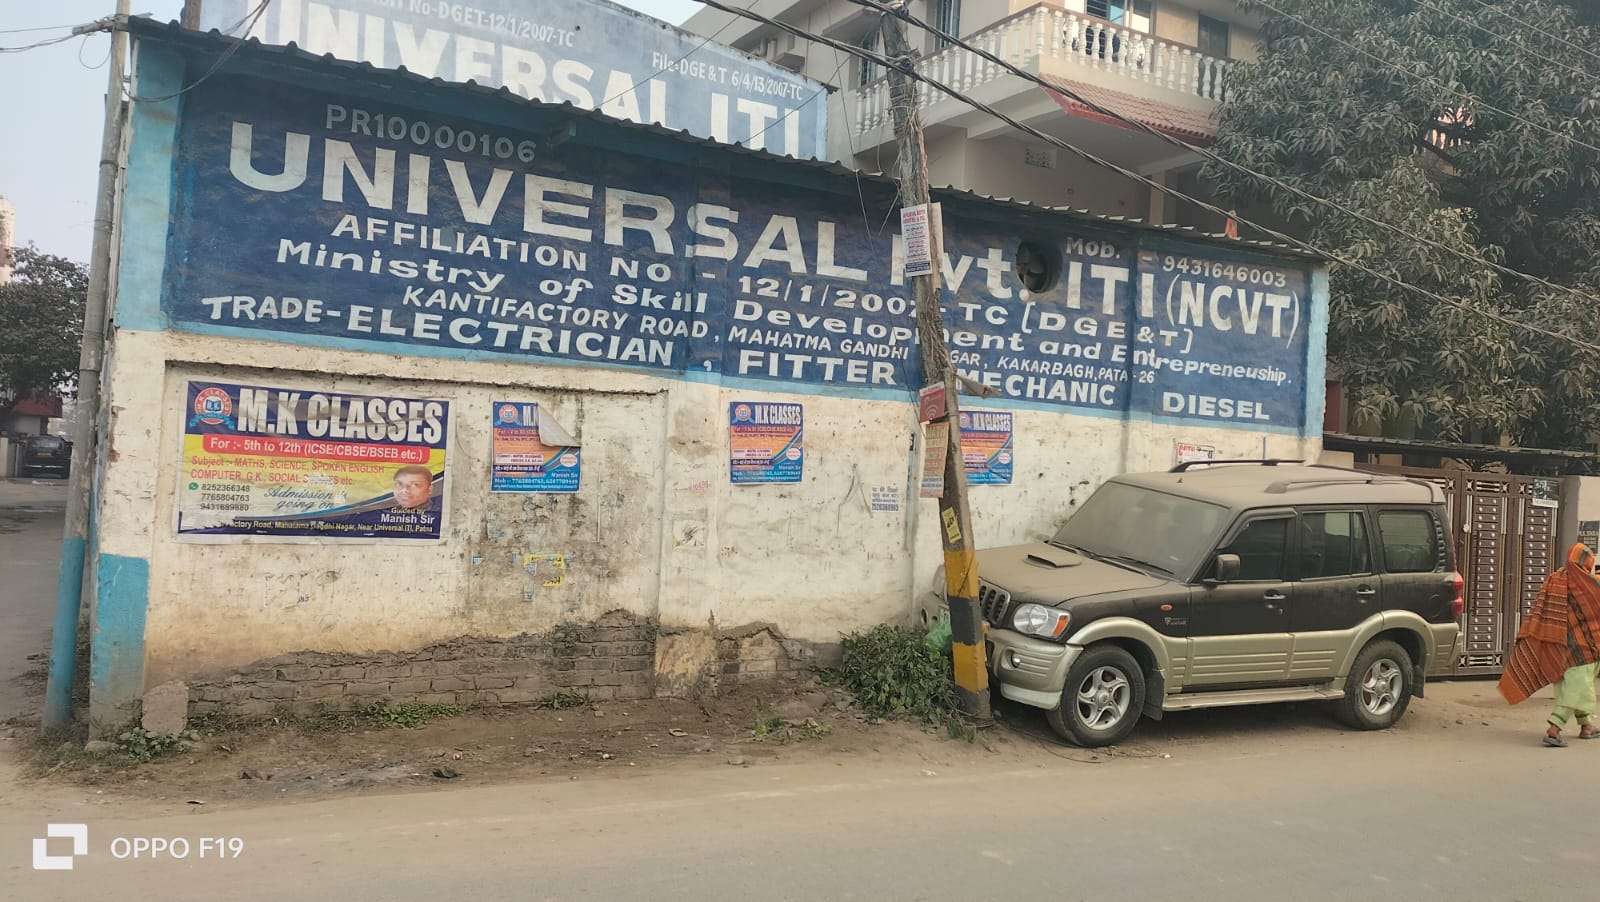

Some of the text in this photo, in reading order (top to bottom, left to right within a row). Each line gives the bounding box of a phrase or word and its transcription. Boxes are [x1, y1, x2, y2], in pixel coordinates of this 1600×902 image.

[325, 103, 537, 163] PR10000106
[711, 92, 800, 159] ITI
[229, 121, 868, 282] UNIVERSAL
[1065, 261, 1155, 319] ITI
[1166, 273, 1300, 349] (NCVT)
[331, 214, 587, 272] AFFILIATION
[276, 238, 505, 293] Ministry
[538, 278, 594, 303] of
[611, 284, 708, 313] Skill
[1038, 341, 1102, 361] and
[1163, 255, 1287, 288] 9431646003
[403, 286, 630, 331] KANTIFACTORY
[727, 326, 833, 352] MAHATMA
[840, 338, 909, 360] GANDHI
[738, 350, 897, 386] FITTER
[955, 368, 1117, 407] MECHANIC
[1162, 391, 1270, 421] DIESEL
[237, 387, 444, 445] M.K CLASSES
[769, 405, 801, 425] CLASSES
[191, 456, 224, 468] Subject
[311, 462, 347, 473] SPOKEN
[348, 463, 385, 474] ENGLISH
[210, 437, 231, 449] For
[243, 439, 260, 452] 5th
[264, 441, 276, 452] to
[278, 441, 301, 453] 12th
[401, 448, 423, 462] etc.)
[269, 472, 301, 483] SOCIAL
[264, 485, 333, 499] Admission
[380, 513, 435, 525] Manish Sir
